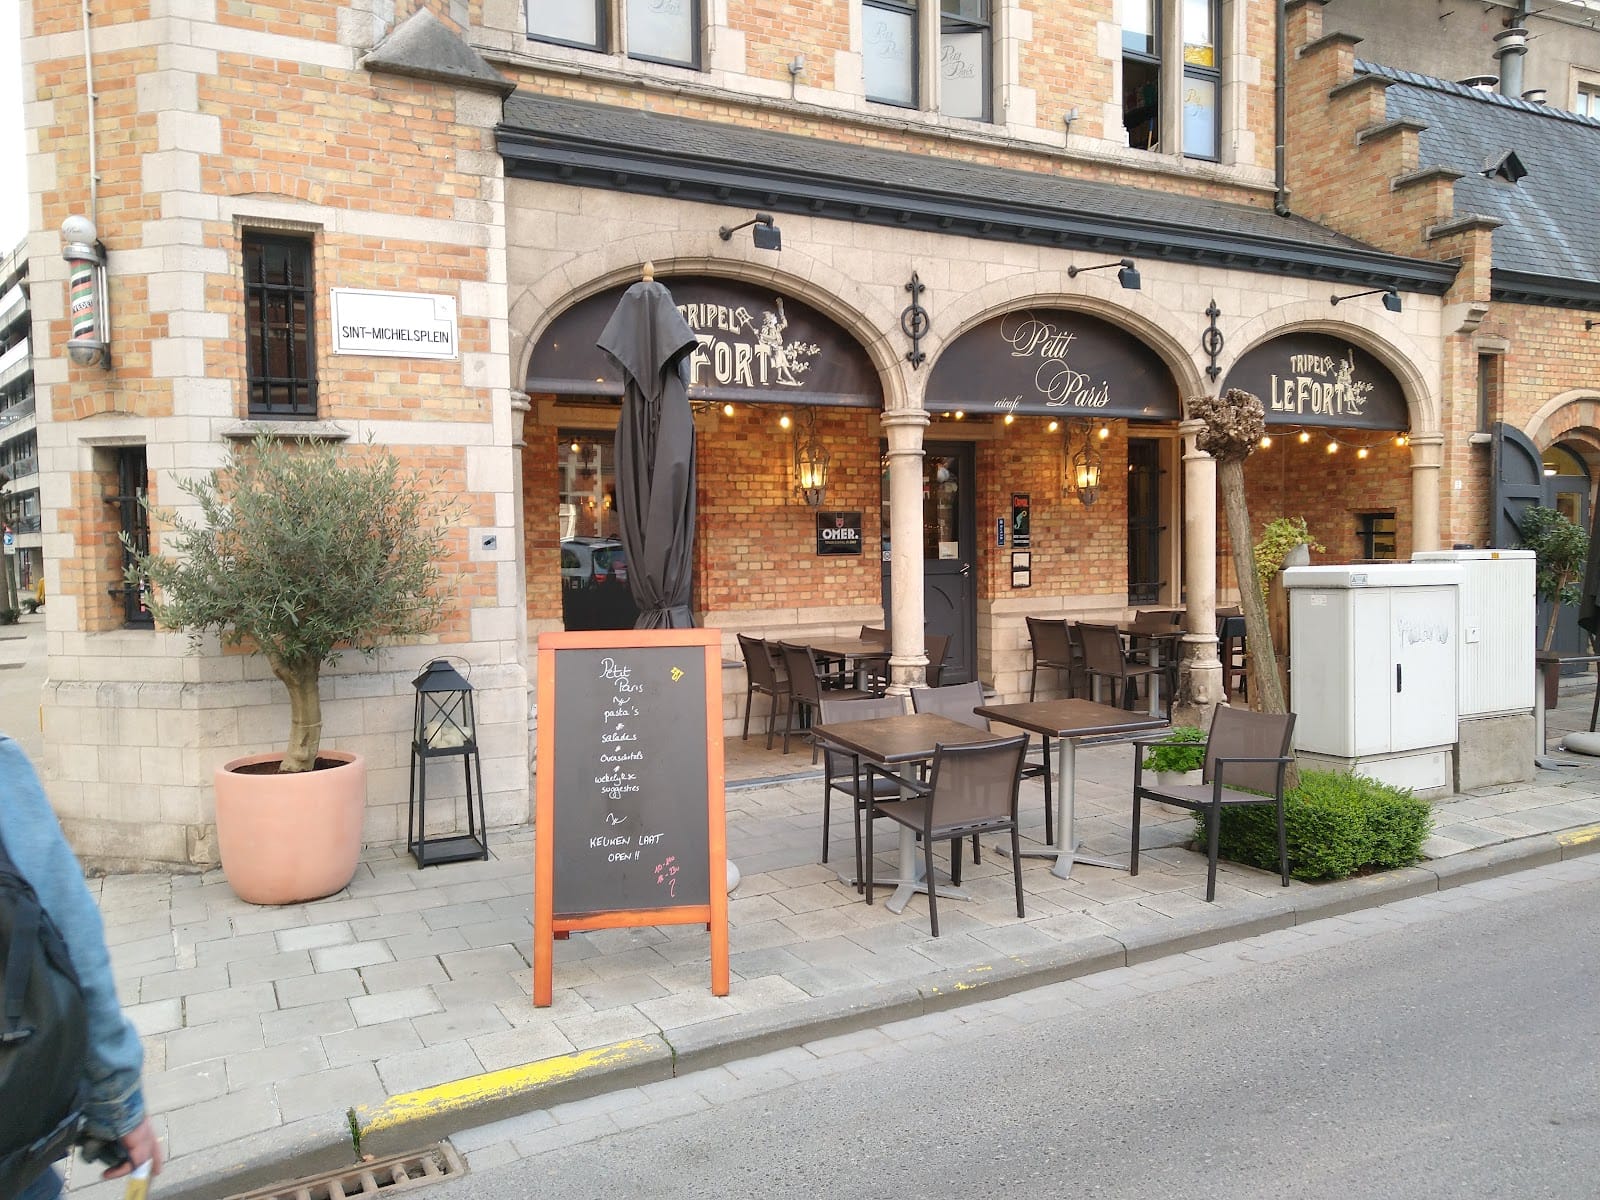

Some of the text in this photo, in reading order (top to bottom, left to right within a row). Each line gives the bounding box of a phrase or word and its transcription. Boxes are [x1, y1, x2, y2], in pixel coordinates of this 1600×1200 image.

[676, 303, 741, 335] TRIPEL
[342, 325, 449, 343] SINT-MICHIELSPLEIN
[1001, 311, 1078, 359] Petit
[688, 334, 770, 387] FORT
[1290, 354, 1328, 377] TRIPEL
[1035, 358, 1111, 408] Paris
[600, 657, 632, 679] Petit
[614, 676, 643, 693] Paris
[604, 705, 640, 723] pasta's
[589, 833, 664, 848] KEUKEN LAAT
